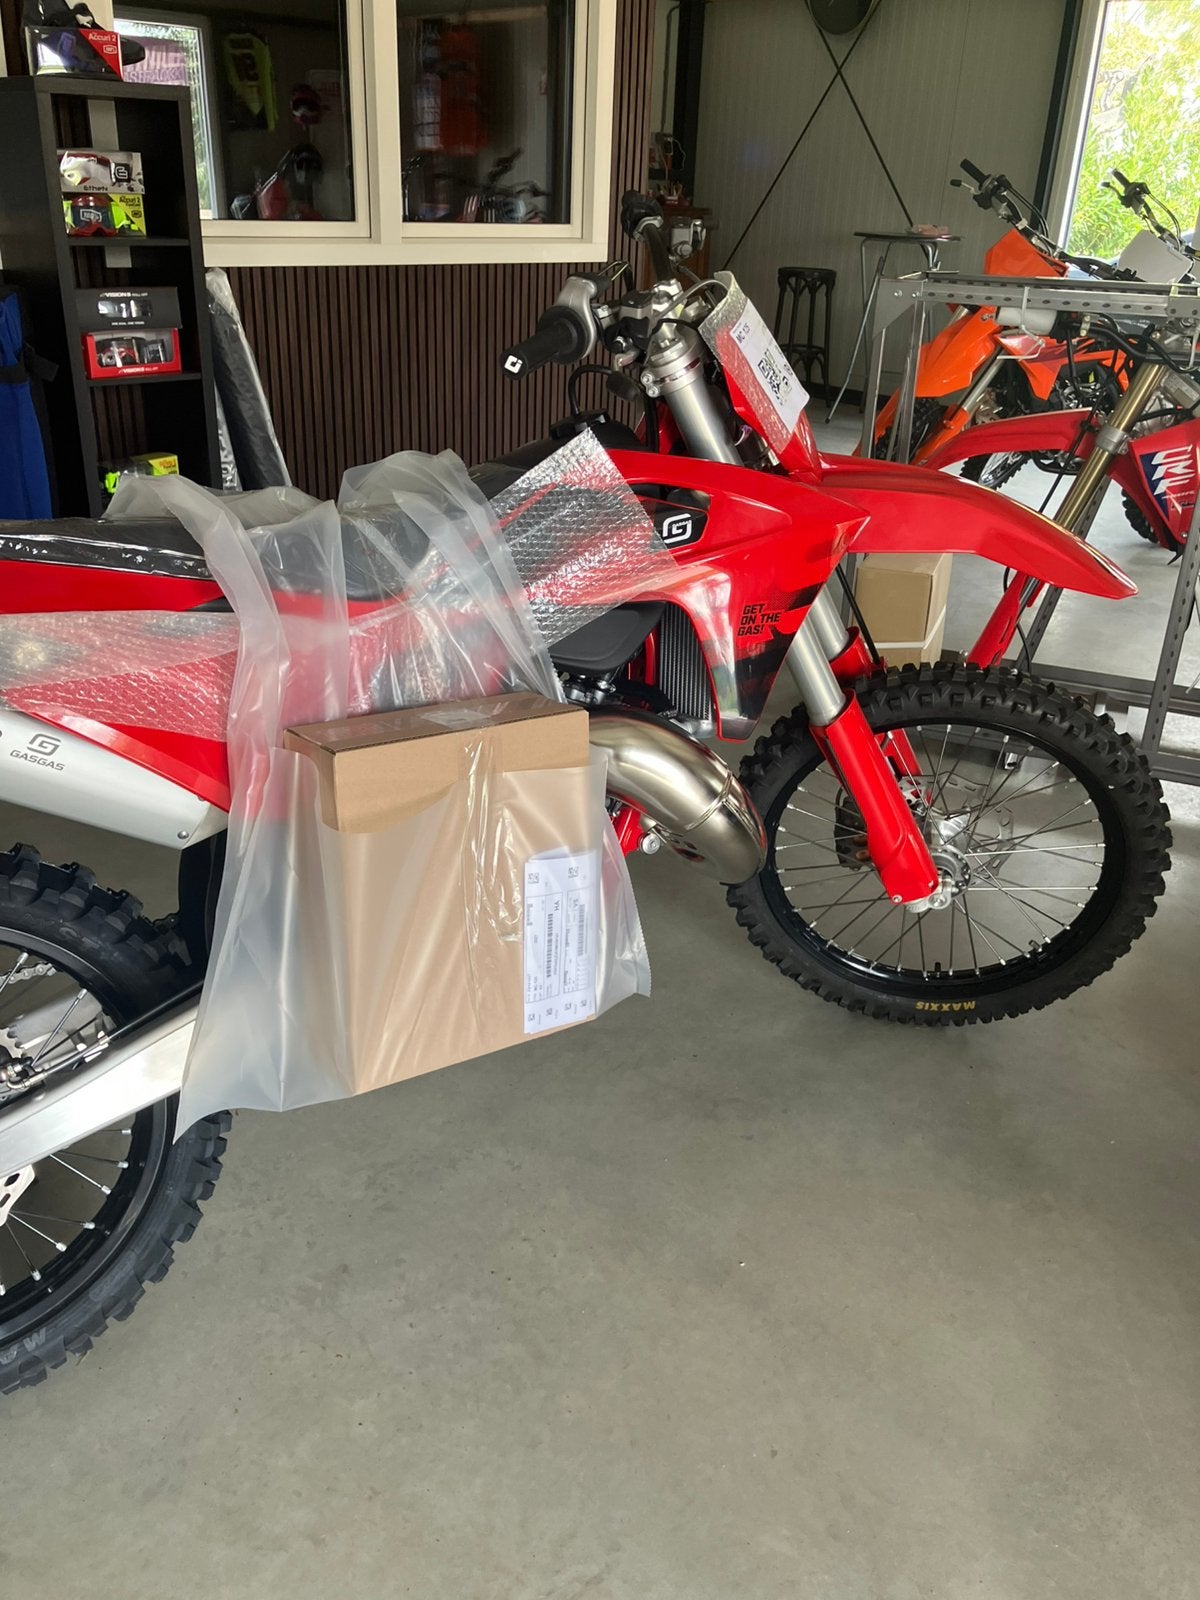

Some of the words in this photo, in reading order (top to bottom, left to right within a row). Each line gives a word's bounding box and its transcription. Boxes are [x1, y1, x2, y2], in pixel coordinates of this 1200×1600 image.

[743, 604, 764, 615] GET
[741, 615, 757, 625] ON
[760, 612, 780, 623] THE
[738, 625, 764, 636] GAS!
[10, 750, 65, 771] GASGAS
[915, 1000, 976, 1012] MAXXIS
